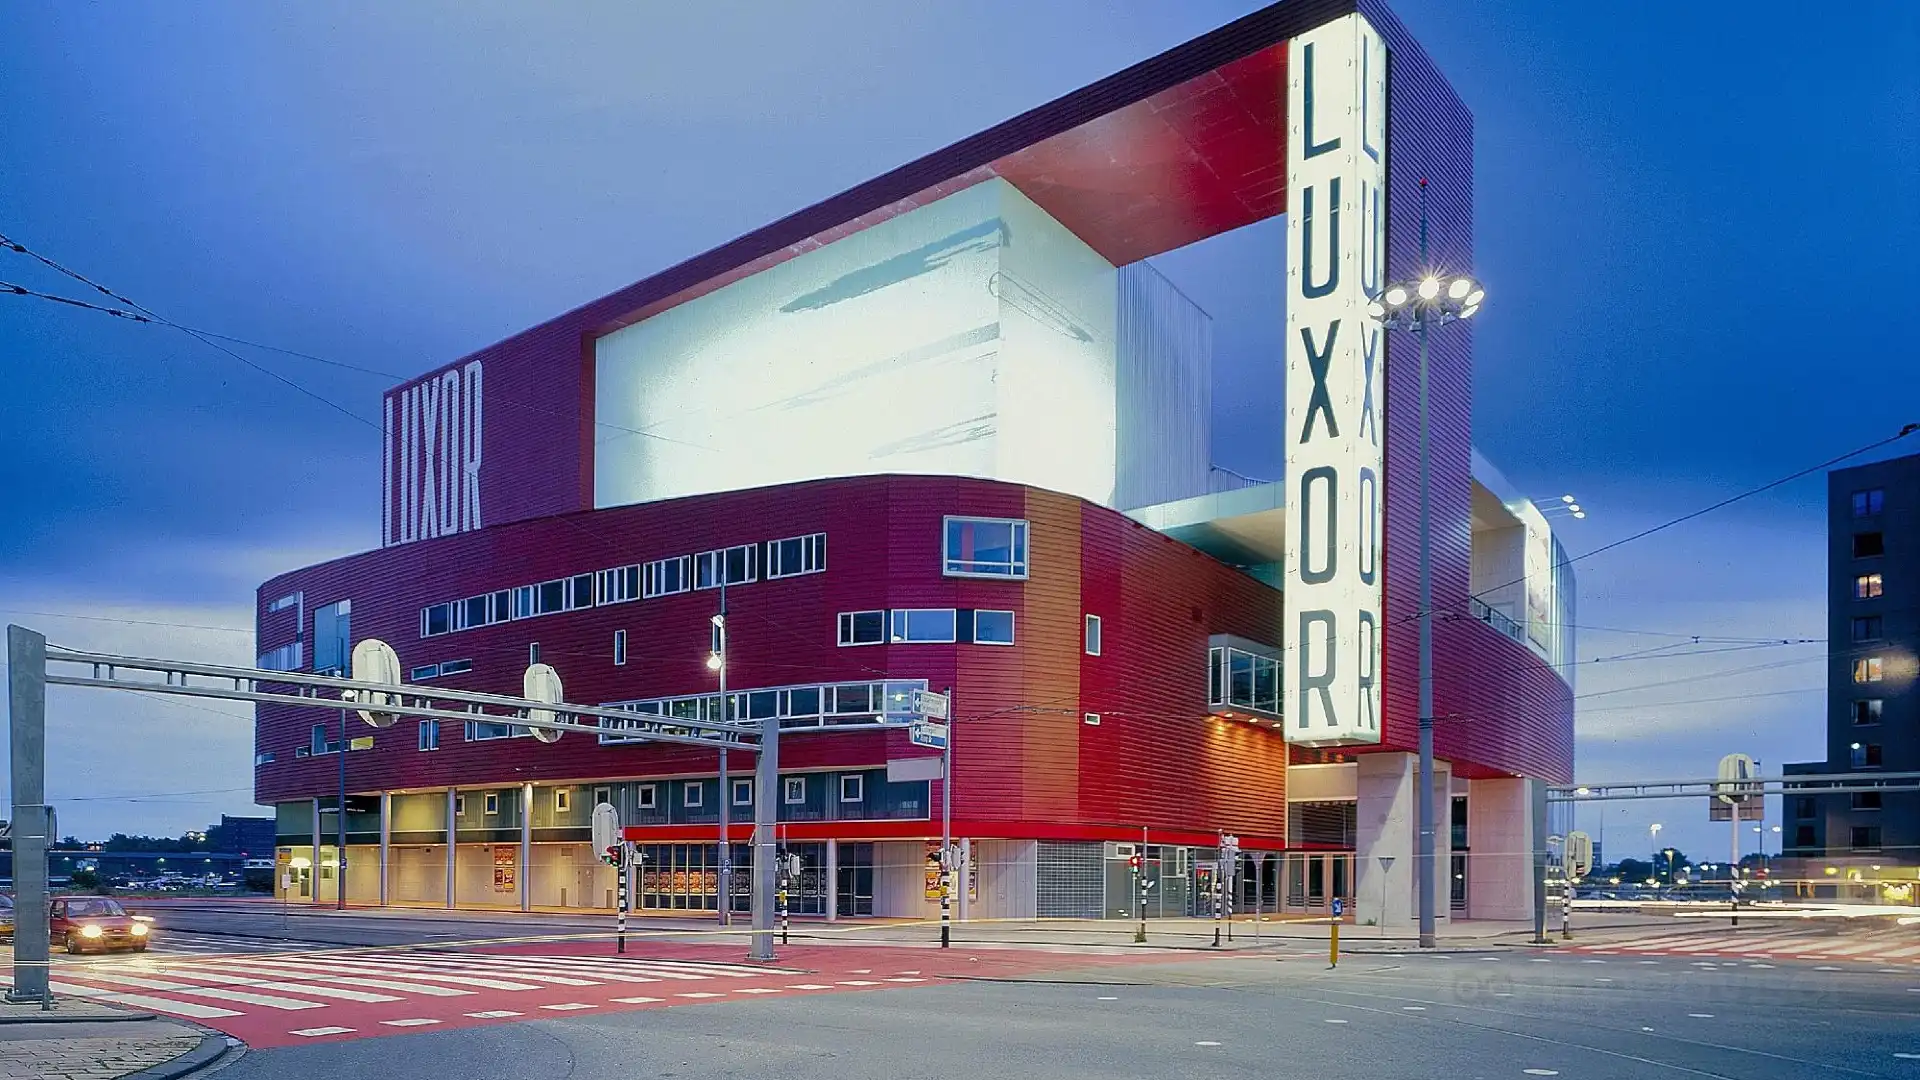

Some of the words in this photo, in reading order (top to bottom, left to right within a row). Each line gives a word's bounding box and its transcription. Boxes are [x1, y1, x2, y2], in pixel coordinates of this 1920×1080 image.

[385, 360, 482, 547] LUXOR
[1299, 42, 1341, 728] LUXOR
[1359, 33, 1379, 730] LUXOR
